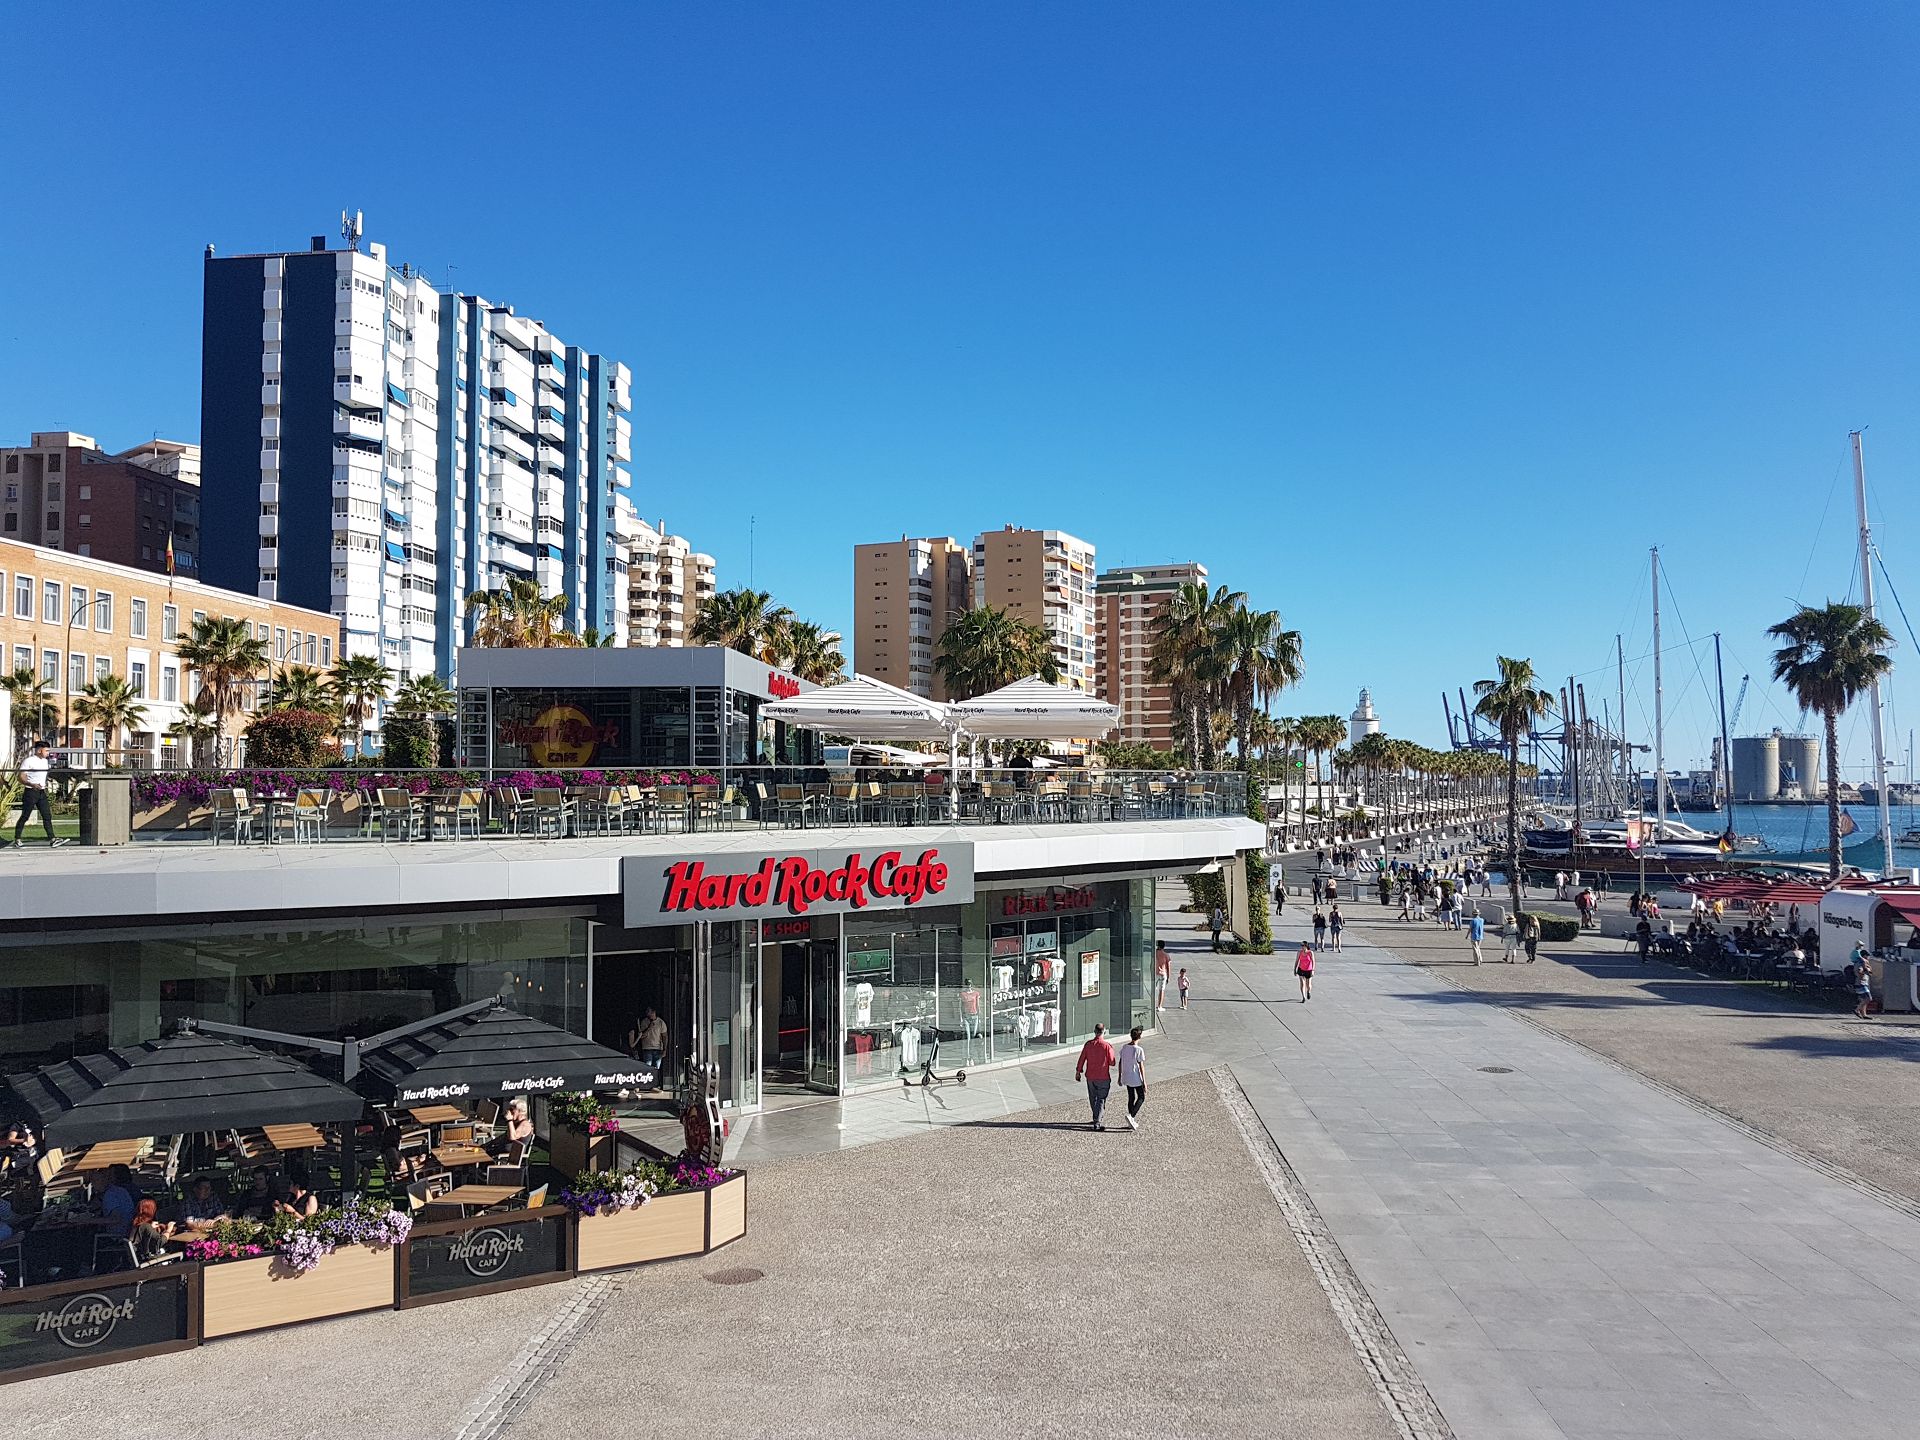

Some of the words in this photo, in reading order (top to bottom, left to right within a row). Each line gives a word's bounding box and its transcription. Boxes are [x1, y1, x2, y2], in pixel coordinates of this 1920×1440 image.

[660, 857, 776, 912] Hard
[773, 853, 869, 914] Rock
[868, 849, 948, 905] Cafe
[776, 921, 809, 934] SHOP
[502, 1079, 524, 1090] Hard
[524, 1078, 545, 1090] Rock
[545, 1077, 564, 1088] Cafe
[595, 1074, 616, 1084] Hard
[616, 1073, 635, 1084] Rock
[636, 1072, 653, 1084] Cafe
[403, 1088, 427, 1100] Hard
[427, 1086, 449, 1099] Rock
[449, 1084, 470, 1096] Cafe
[448, 1240, 487, 1261] Hard
[488, 1234, 524, 1257] Rock
[478, 1258, 497, 1267] CAFE
[36, 1306, 86, 1331] Hard
[88, 1299, 134, 1324] Rock
[74, 1327, 99, 1338] CAFE
